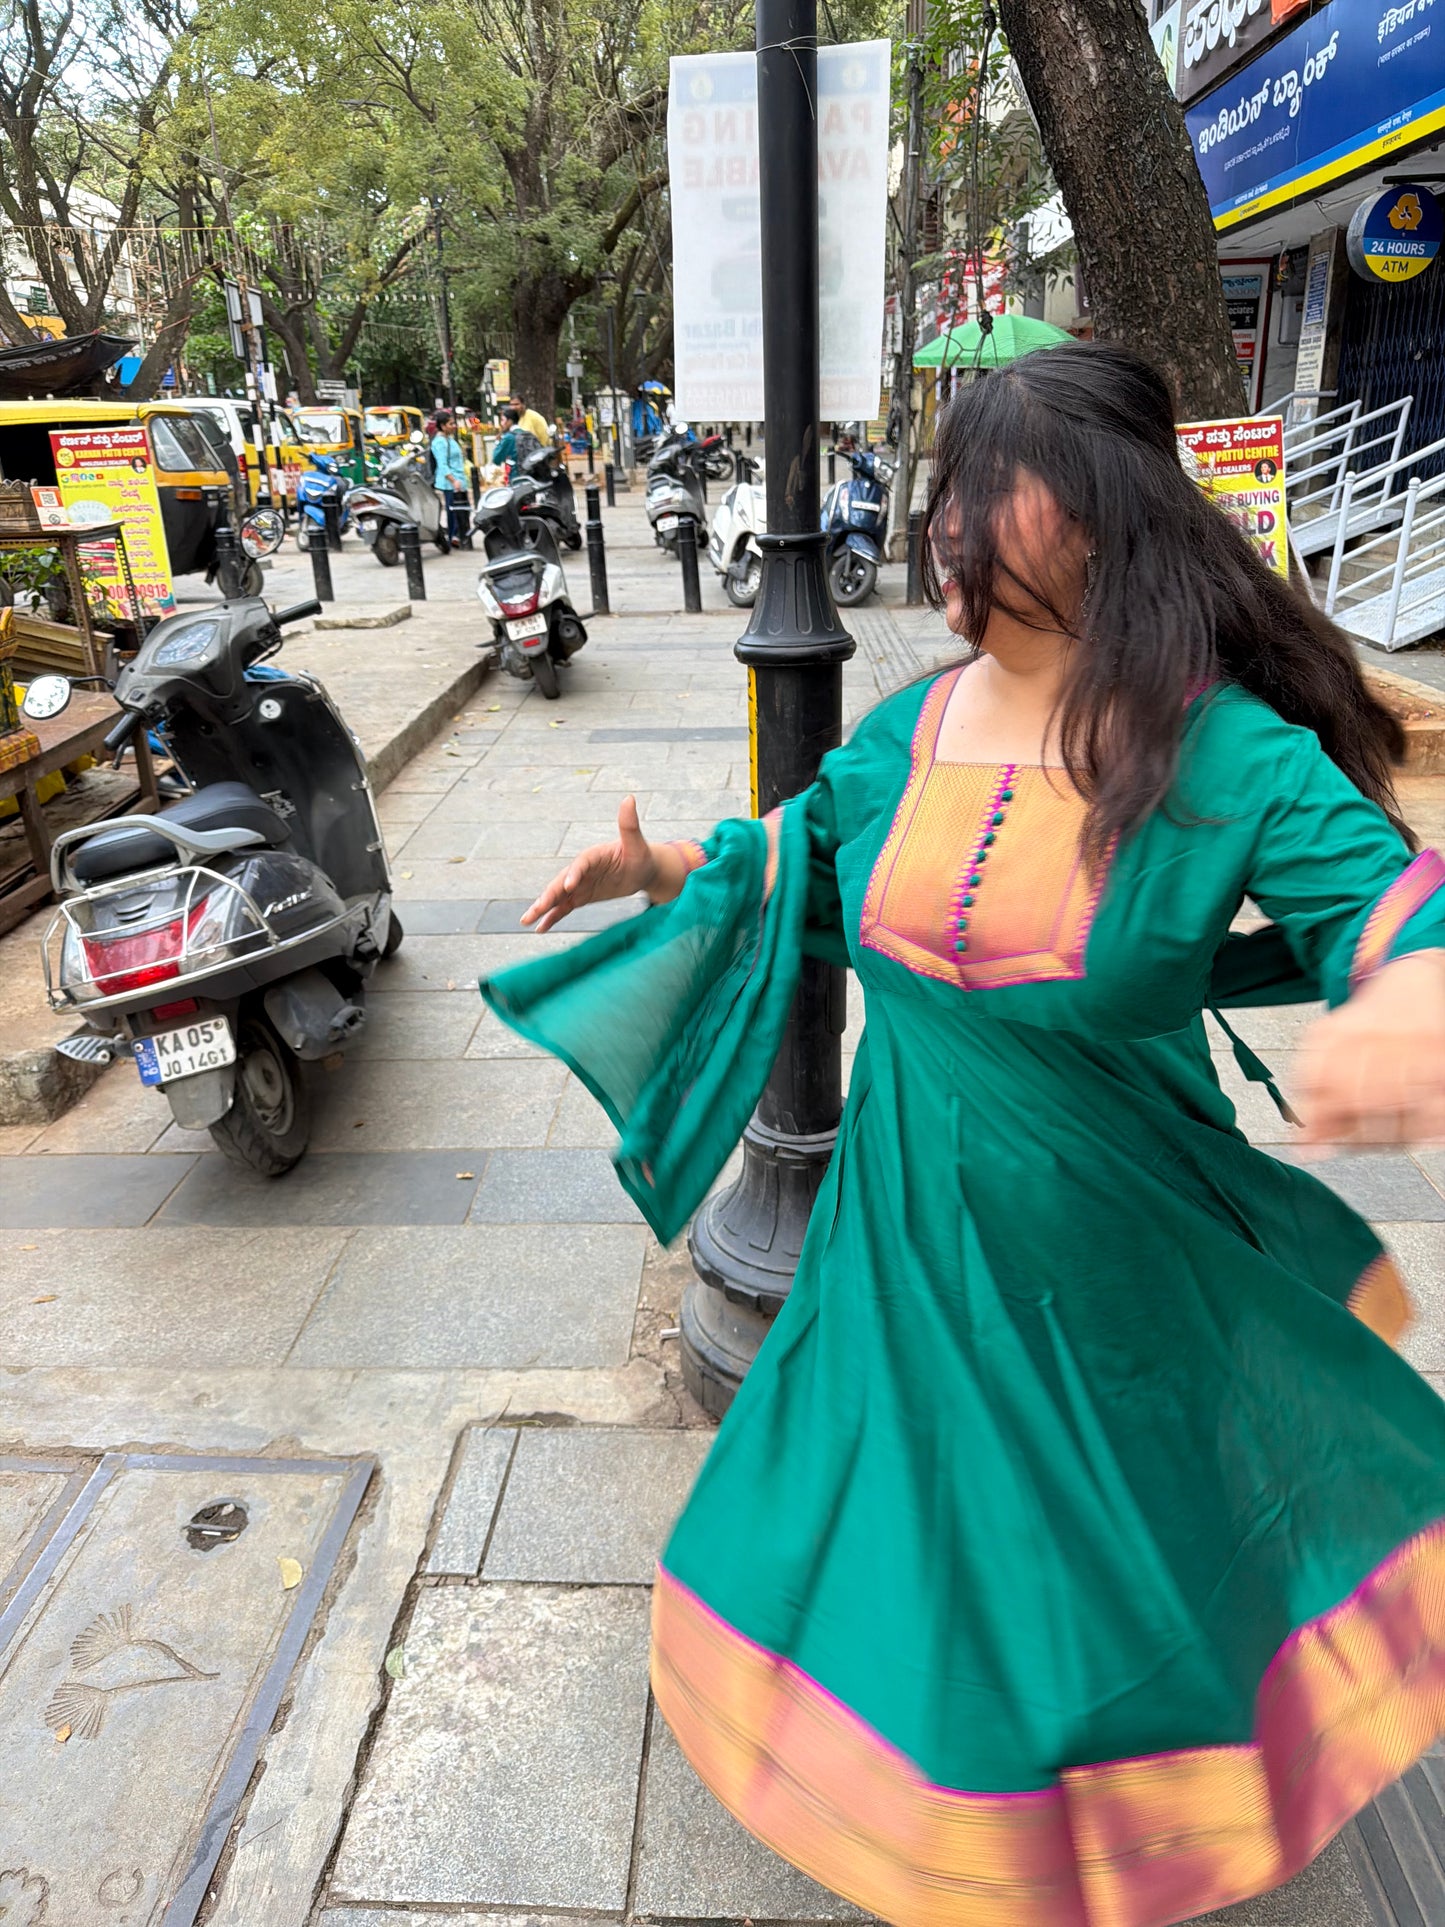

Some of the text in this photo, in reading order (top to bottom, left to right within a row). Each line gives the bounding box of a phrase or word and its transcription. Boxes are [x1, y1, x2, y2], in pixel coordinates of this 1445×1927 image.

[1371, 240, 1426, 256] 24 HOURS
[1381, 260, 1409, 274] ATM
[1216, 448, 1244, 463] PATTU
[1245, 445, 1279, 460] CENTRE
[1222, 463, 1252, 475] DEALERS
[1237, 489, 1280, 506] BUYING
[157, 1023, 216, 1058] KA 05
